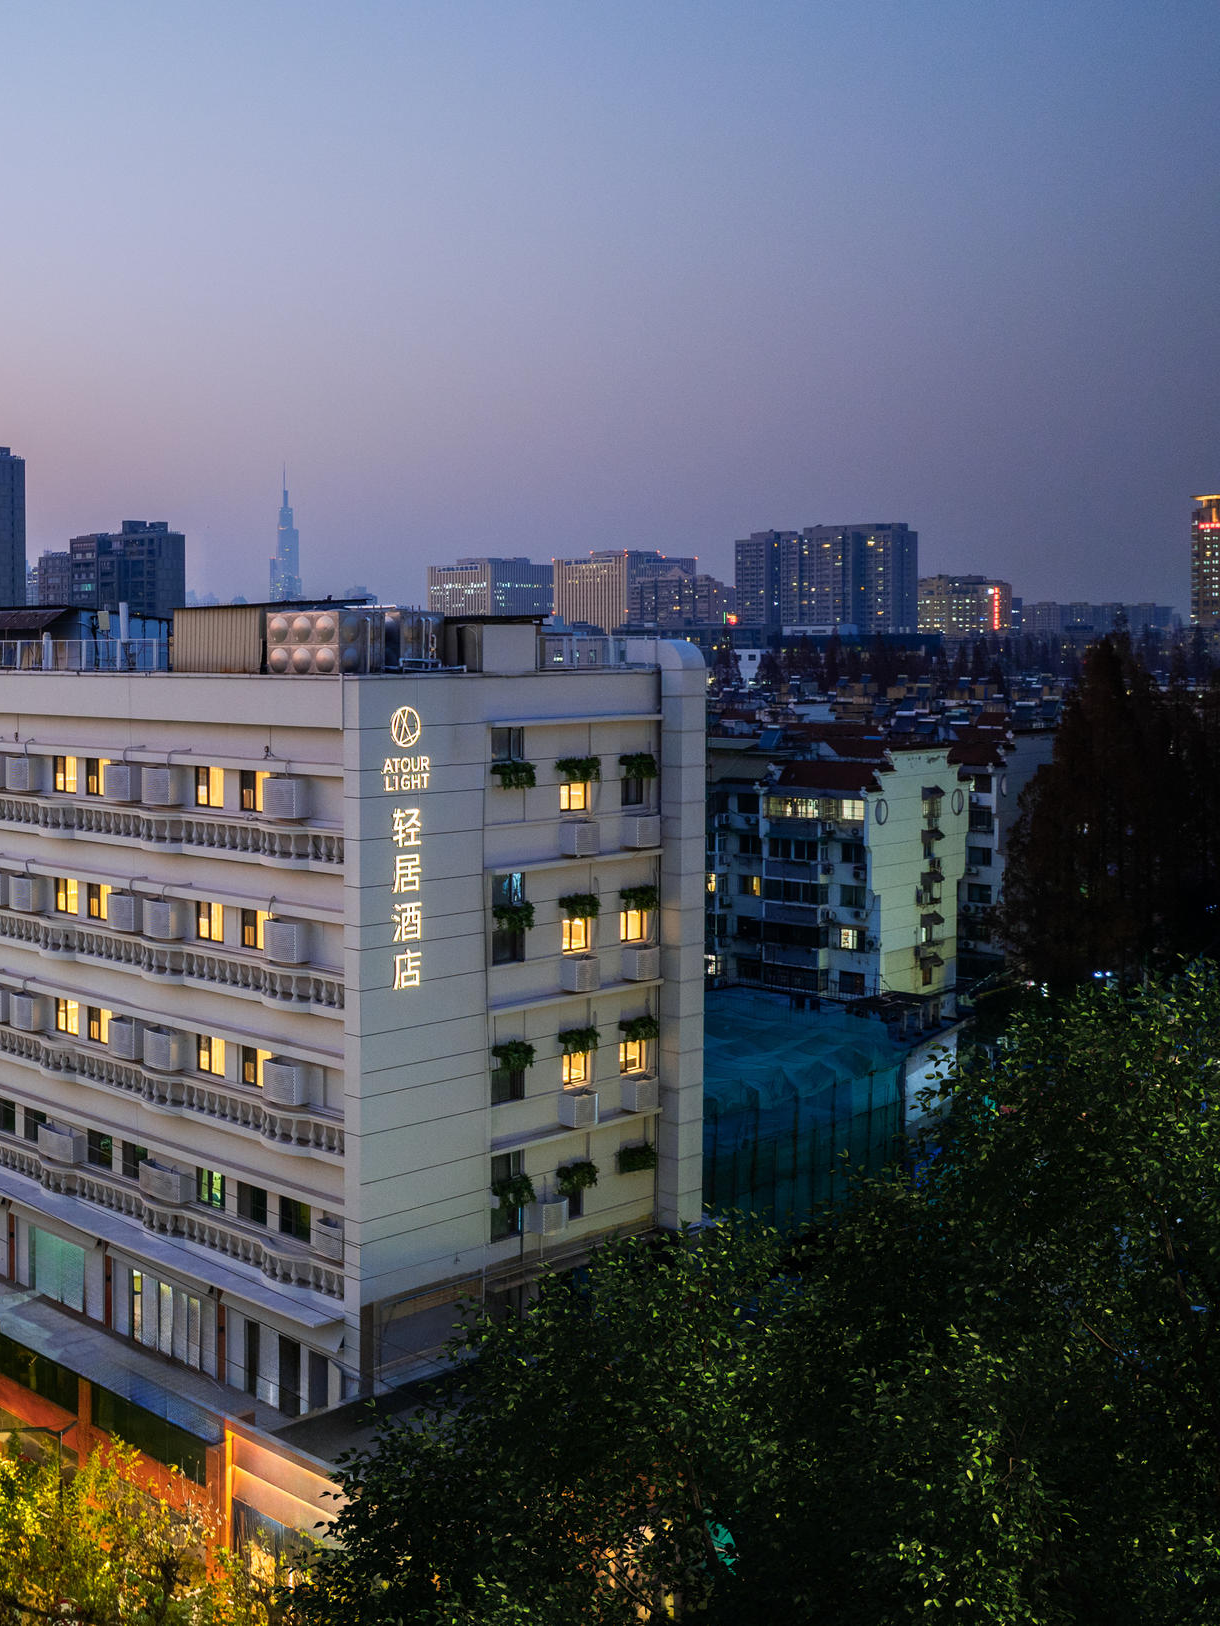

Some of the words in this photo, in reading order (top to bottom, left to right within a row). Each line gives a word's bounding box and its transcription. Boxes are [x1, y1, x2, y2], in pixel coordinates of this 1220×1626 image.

[382, 756, 430, 774] ATOUR
[384, 773, 430, 792] LIGHT
[391, 807, 422, 991] 轻居酒店
